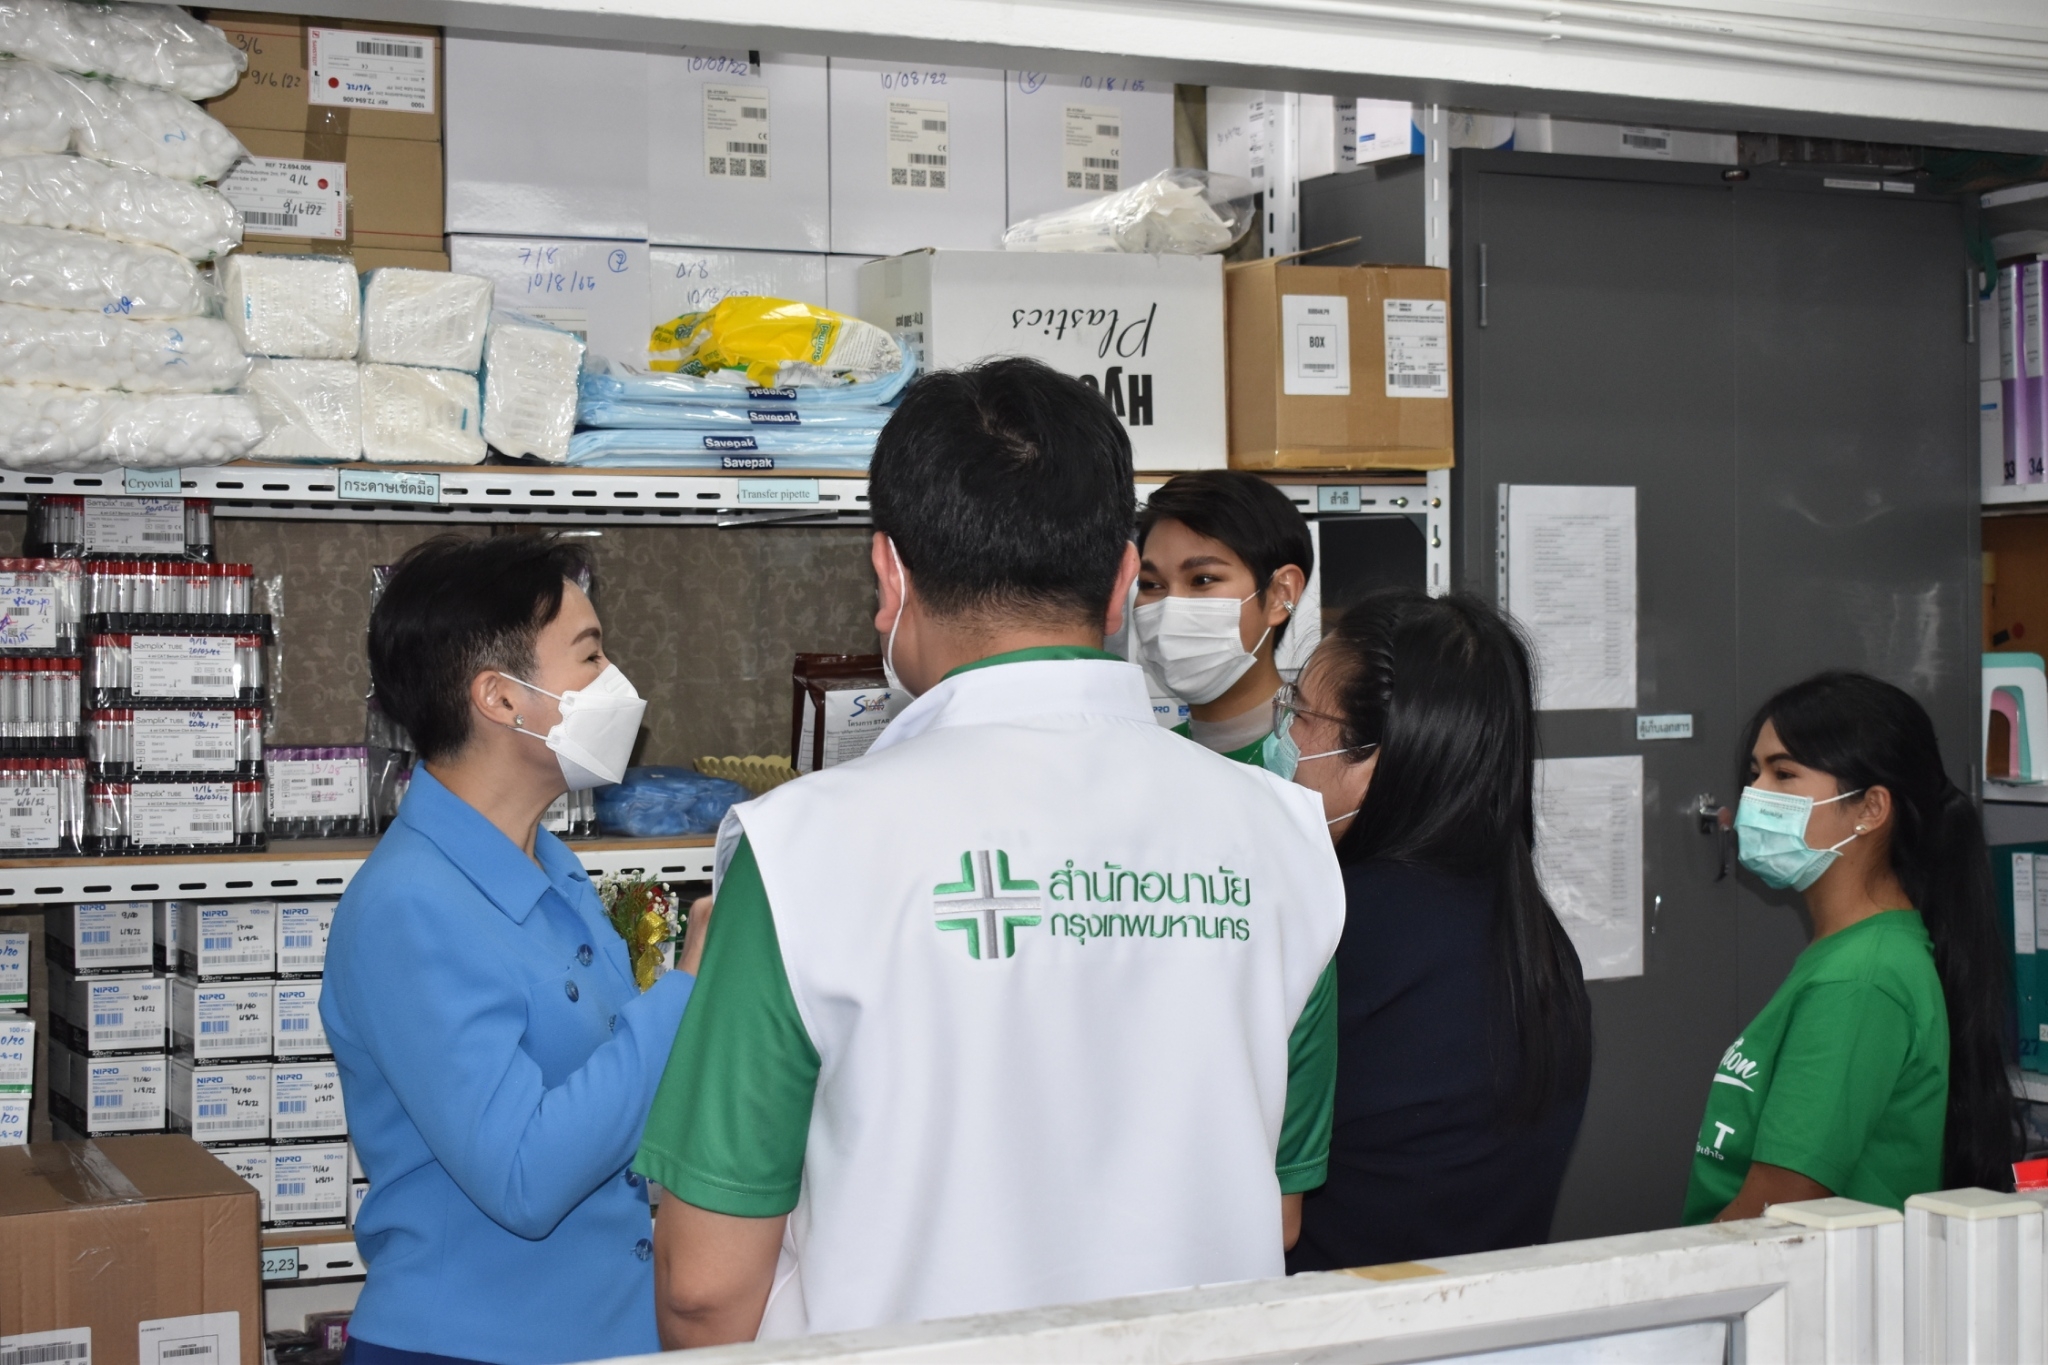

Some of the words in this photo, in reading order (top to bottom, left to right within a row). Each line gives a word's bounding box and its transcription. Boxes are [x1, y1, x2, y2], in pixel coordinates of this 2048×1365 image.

[237, 34, 262, 54] 3/6
[1012, 302, 1158, 359] Plastics
[1309, 336, 1325, 348] BOX
[750, 412, 798, 422] Savepak
[705, 438, 754, 448] Savepak
[723, 457, 773, 469] Savepak
[2004, 460, 2016, 480] 33
[2028, 457, 2044, 477] 34
[127, 478, 174, 491] Cryovial
[344, 477, 434, 496] กระดาษเช็ดมือ
[741, 489, 778, 498] Transfer
[780, 489, 810, 500] pipette
[1049, 859, 1250, 907] สำนักอนามัย
[80, 903, 106, 911] NIPRO
[1051, 913, 1250, 945] กรุงเทพมหานคร
[196, 1076, 223, 1084] NIPRO
[1715, 1121, 1735, 1150] T
